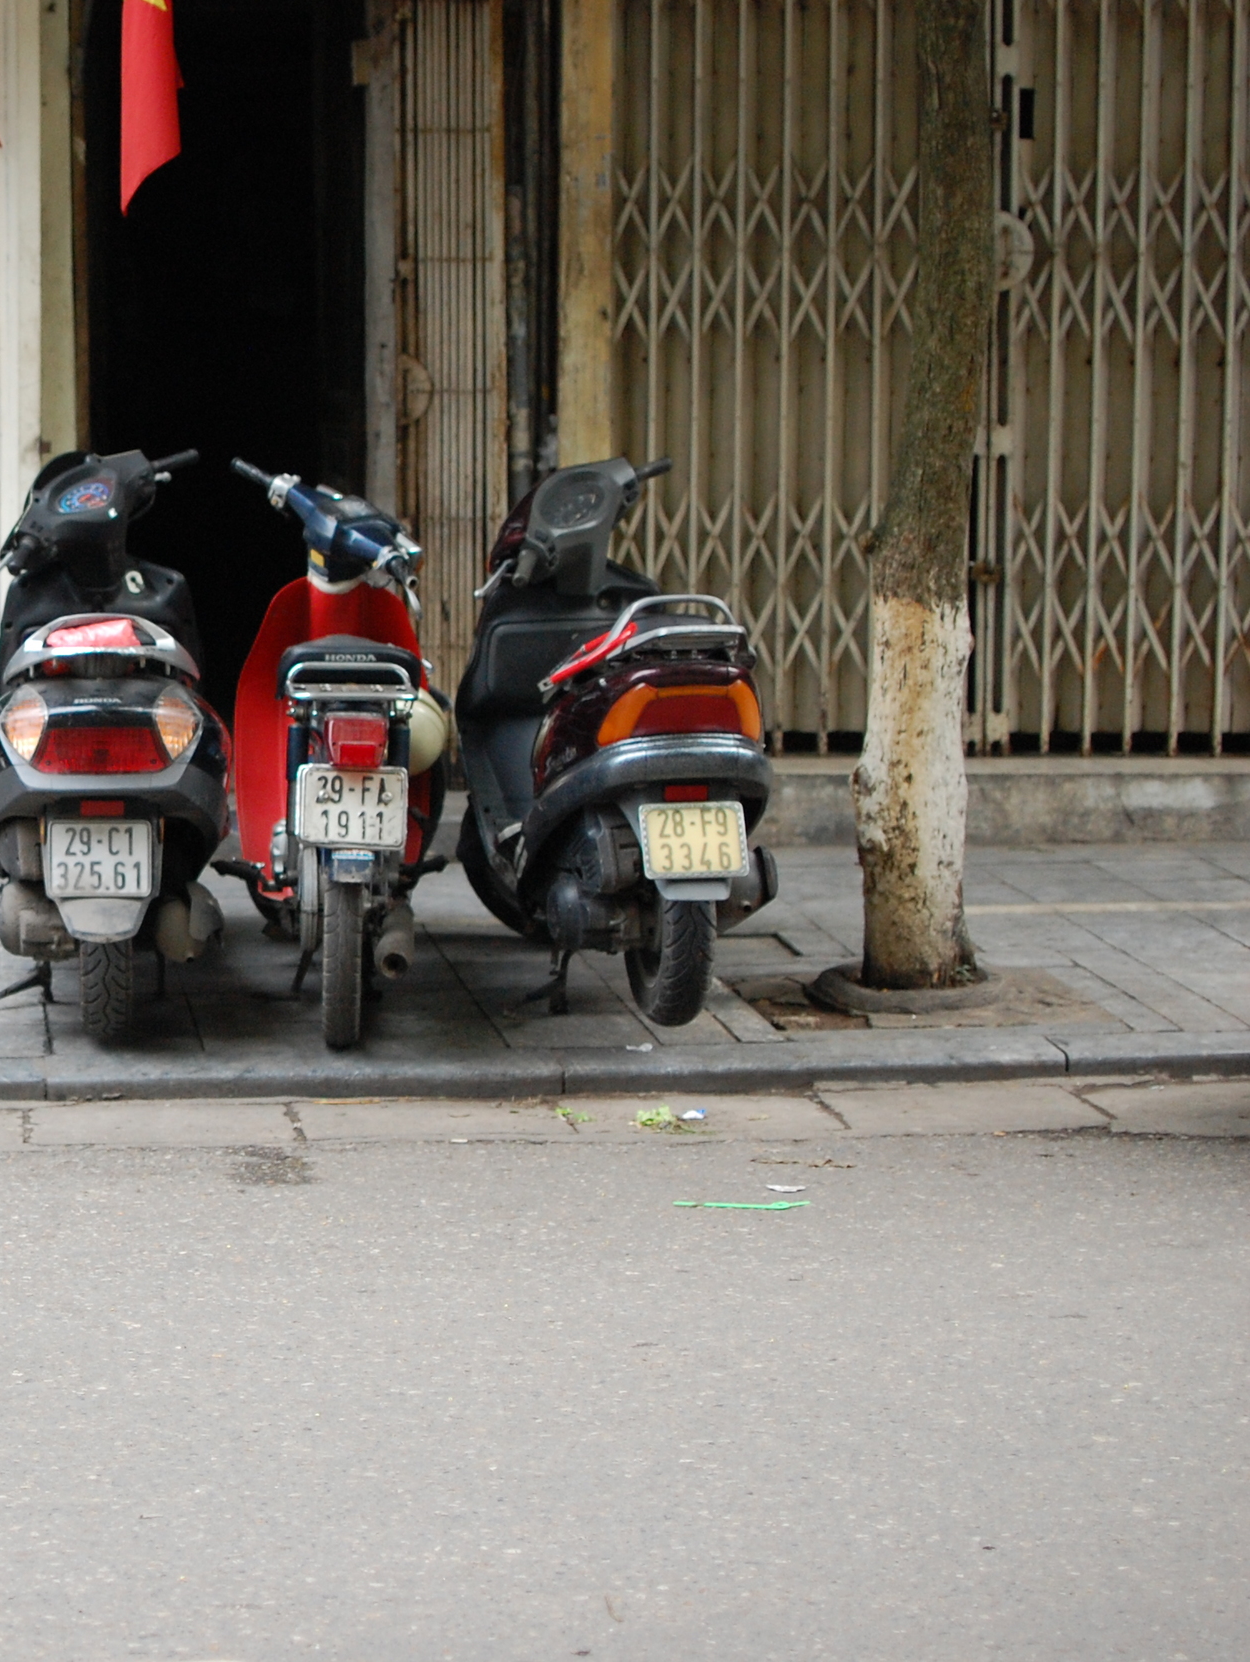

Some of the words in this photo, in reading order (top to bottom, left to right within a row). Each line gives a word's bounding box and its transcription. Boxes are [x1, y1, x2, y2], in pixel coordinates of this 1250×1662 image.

[325, 653, 377, 662] HONDA
[316, 775, 391, 806] 29-FA
[321, 809, 384, 840] 1911
[657, 807, 728, 838] 28-F9
[64, 826, 134, 856] 29-C1
[660, 842, 732, 871] 3346
[56, 861, 141, 891] 325.61
